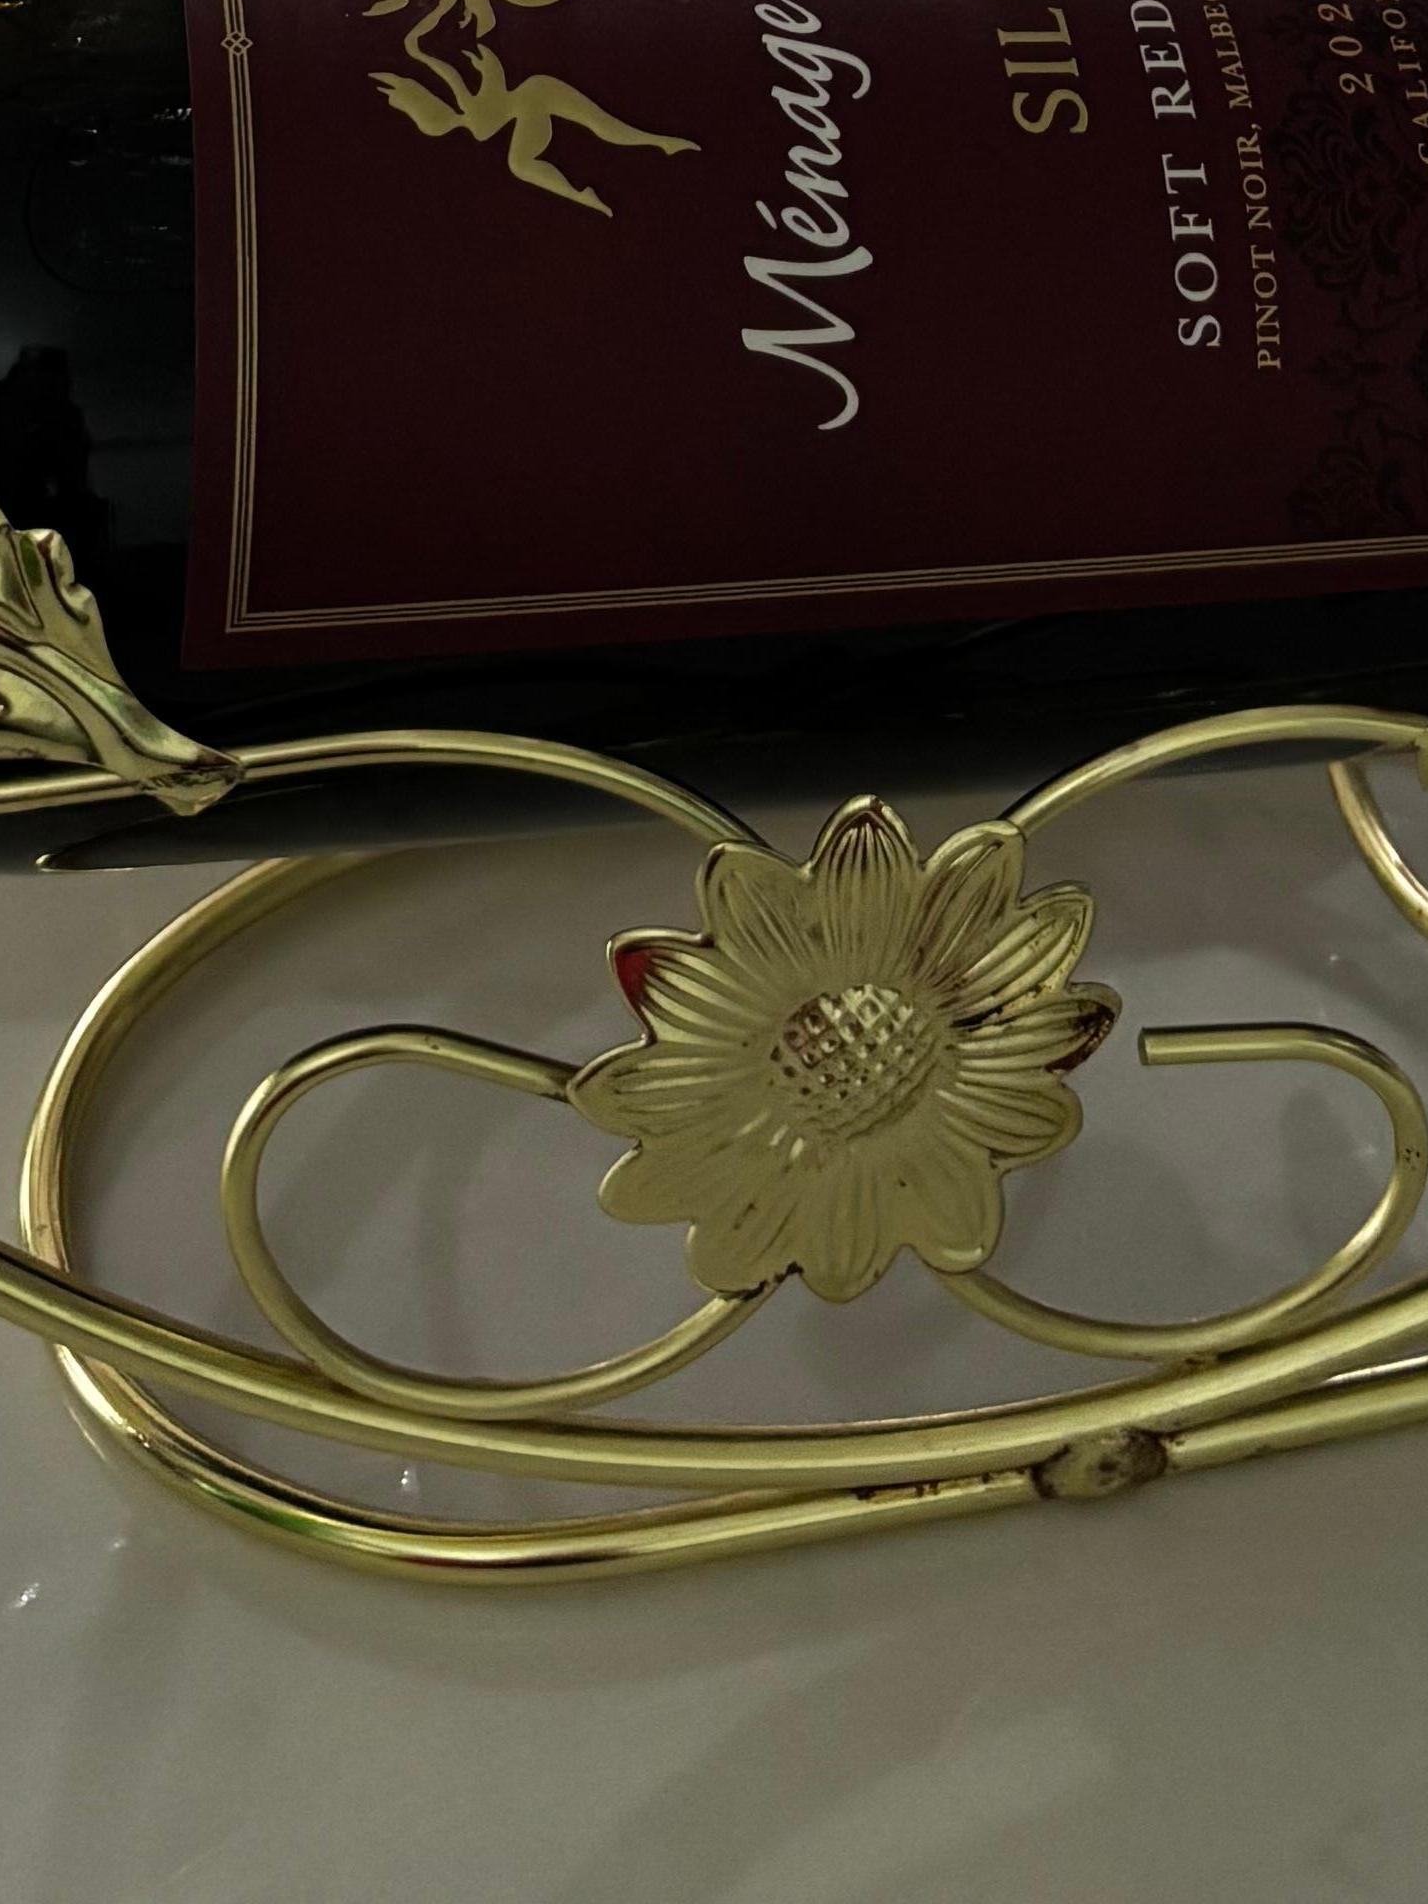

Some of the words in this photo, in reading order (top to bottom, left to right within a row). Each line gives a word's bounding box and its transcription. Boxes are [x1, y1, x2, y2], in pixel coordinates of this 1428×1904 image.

[1235, 122, 1273, 231] NOIR,
[1161, 153, 1222, 347] SOFT
[1250, 244, 1282, 370] PINOT
